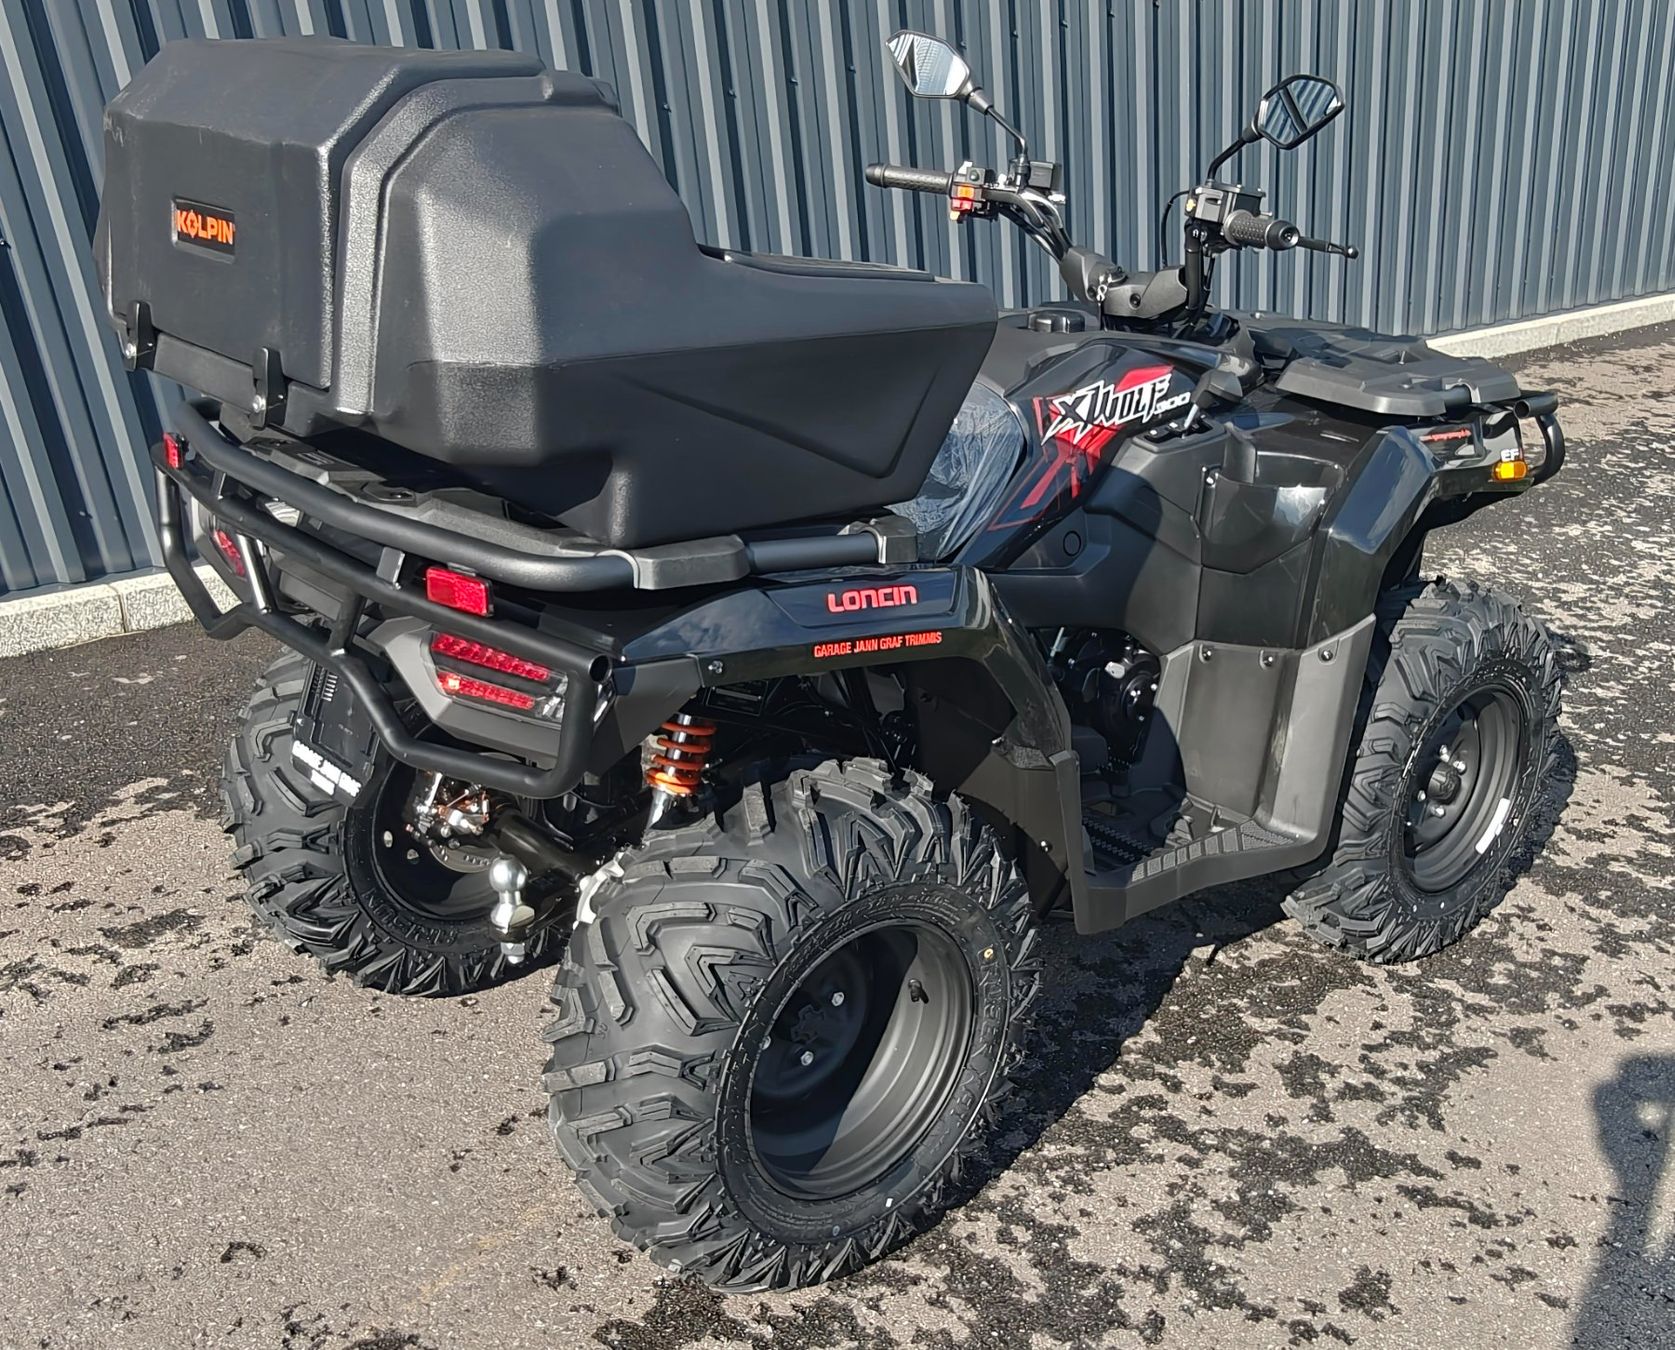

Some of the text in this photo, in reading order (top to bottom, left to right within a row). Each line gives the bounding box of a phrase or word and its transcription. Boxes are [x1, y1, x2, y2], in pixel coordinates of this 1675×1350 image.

[176, 209, 235, 245] KOLPIN
[827, 585, 918, 613] LONCIN
[814, 631, 942, 658] GARAGE JANN GRAF TRIMMIS
